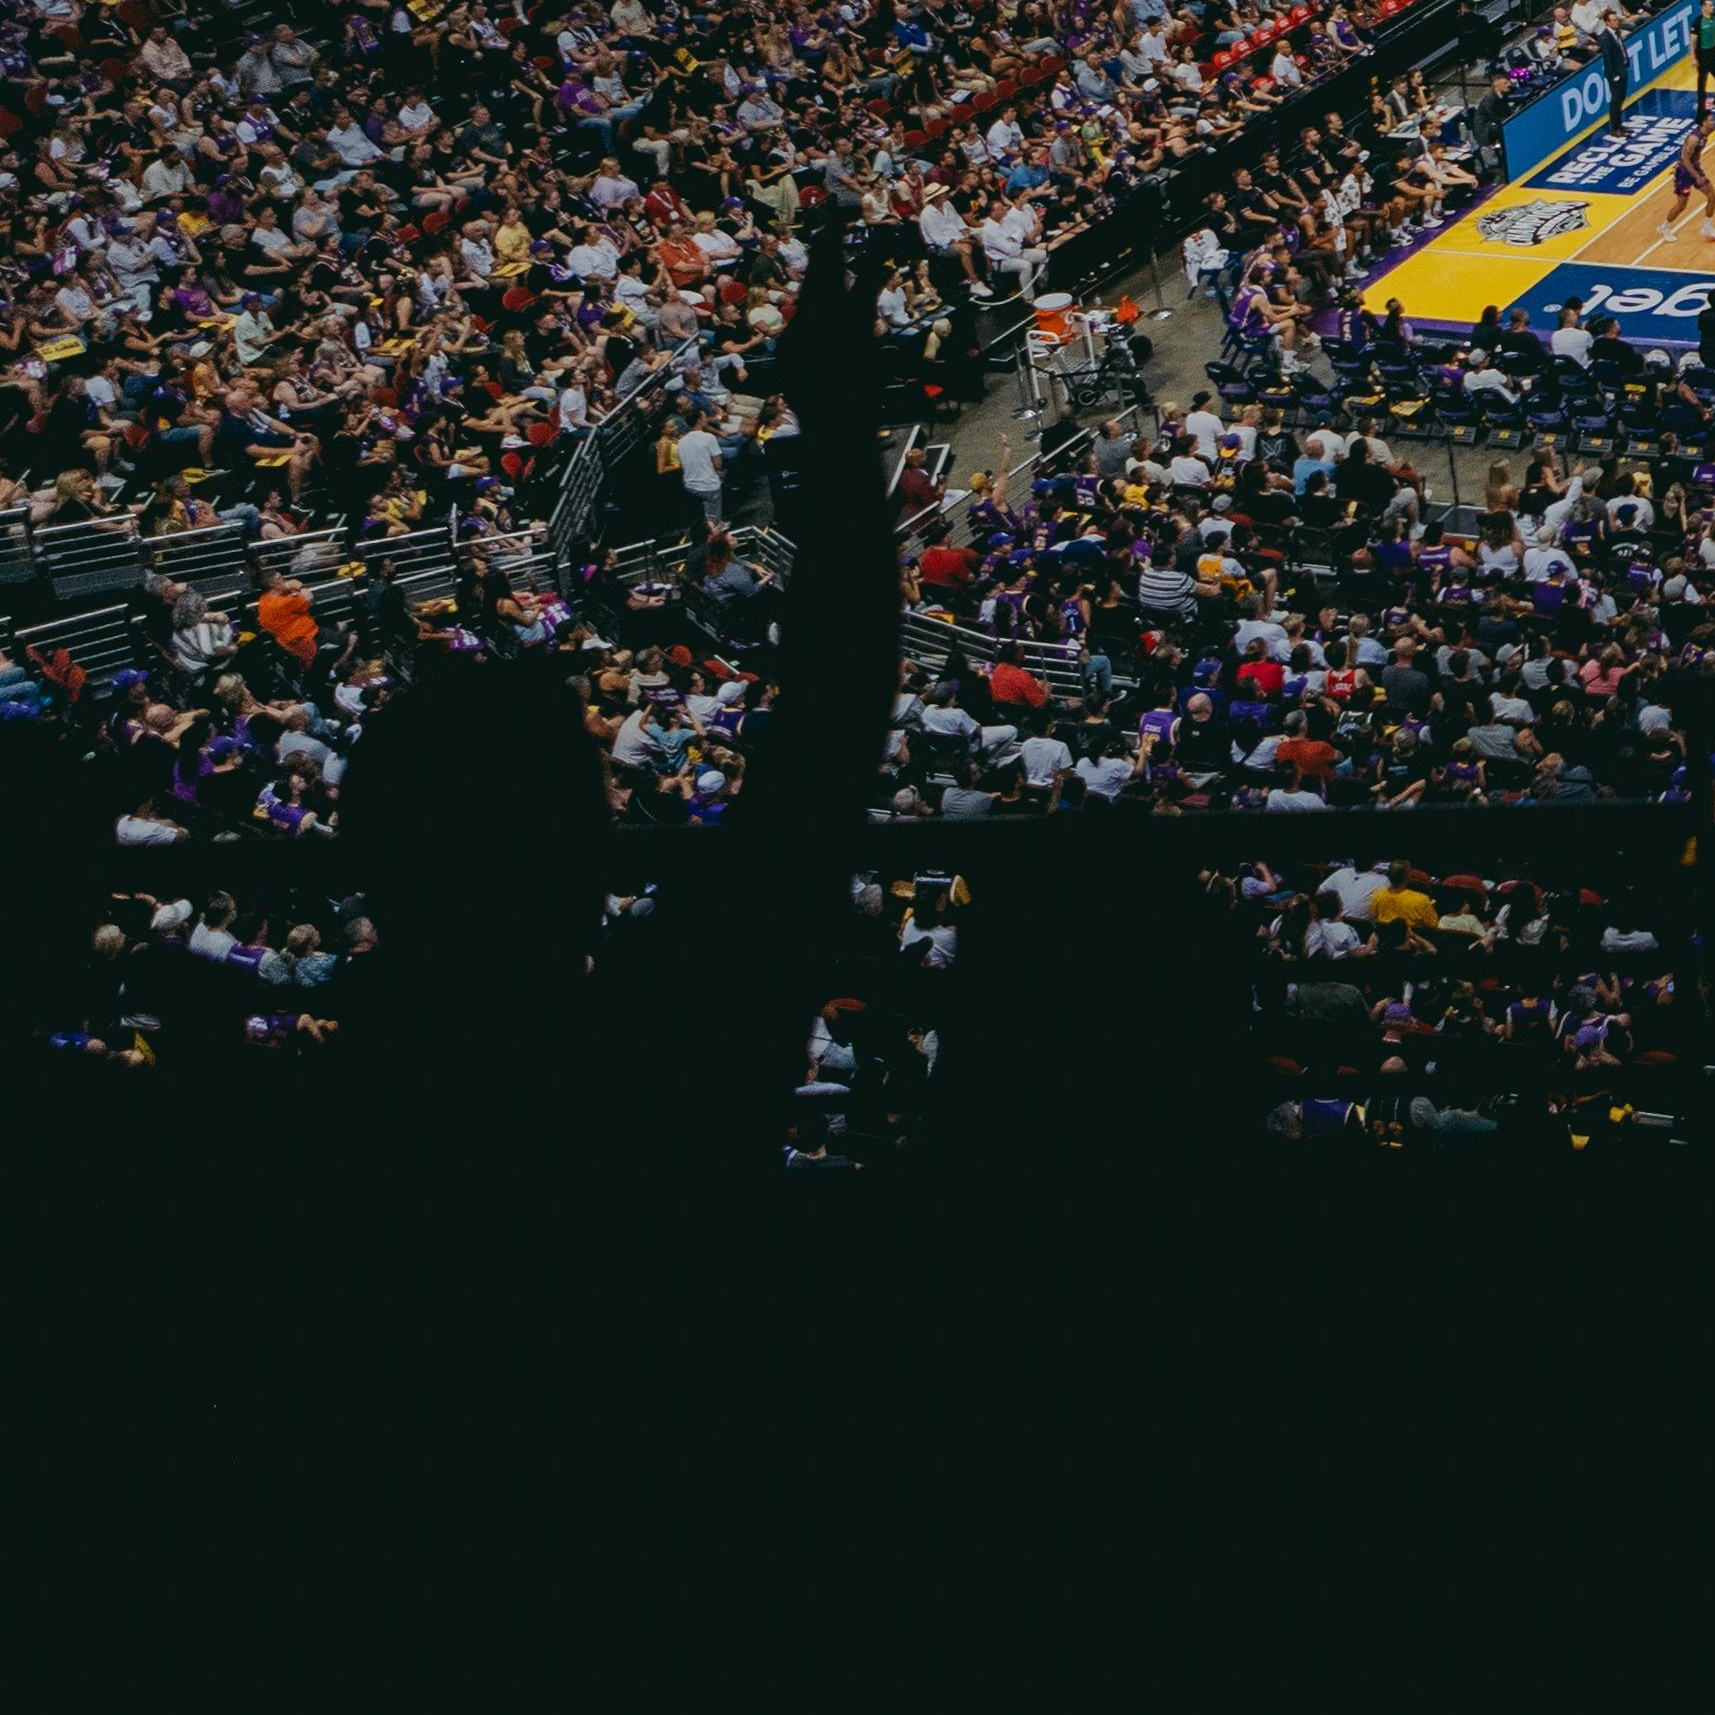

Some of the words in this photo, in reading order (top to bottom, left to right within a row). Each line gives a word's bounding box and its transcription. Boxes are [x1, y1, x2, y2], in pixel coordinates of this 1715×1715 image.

[1562, 41, 1643, 133] DOT
[1648, 5, 1694, 71] LET
[1580, 166, 1616, 185] THE
[1609, 117, 1694, 169] GAME
